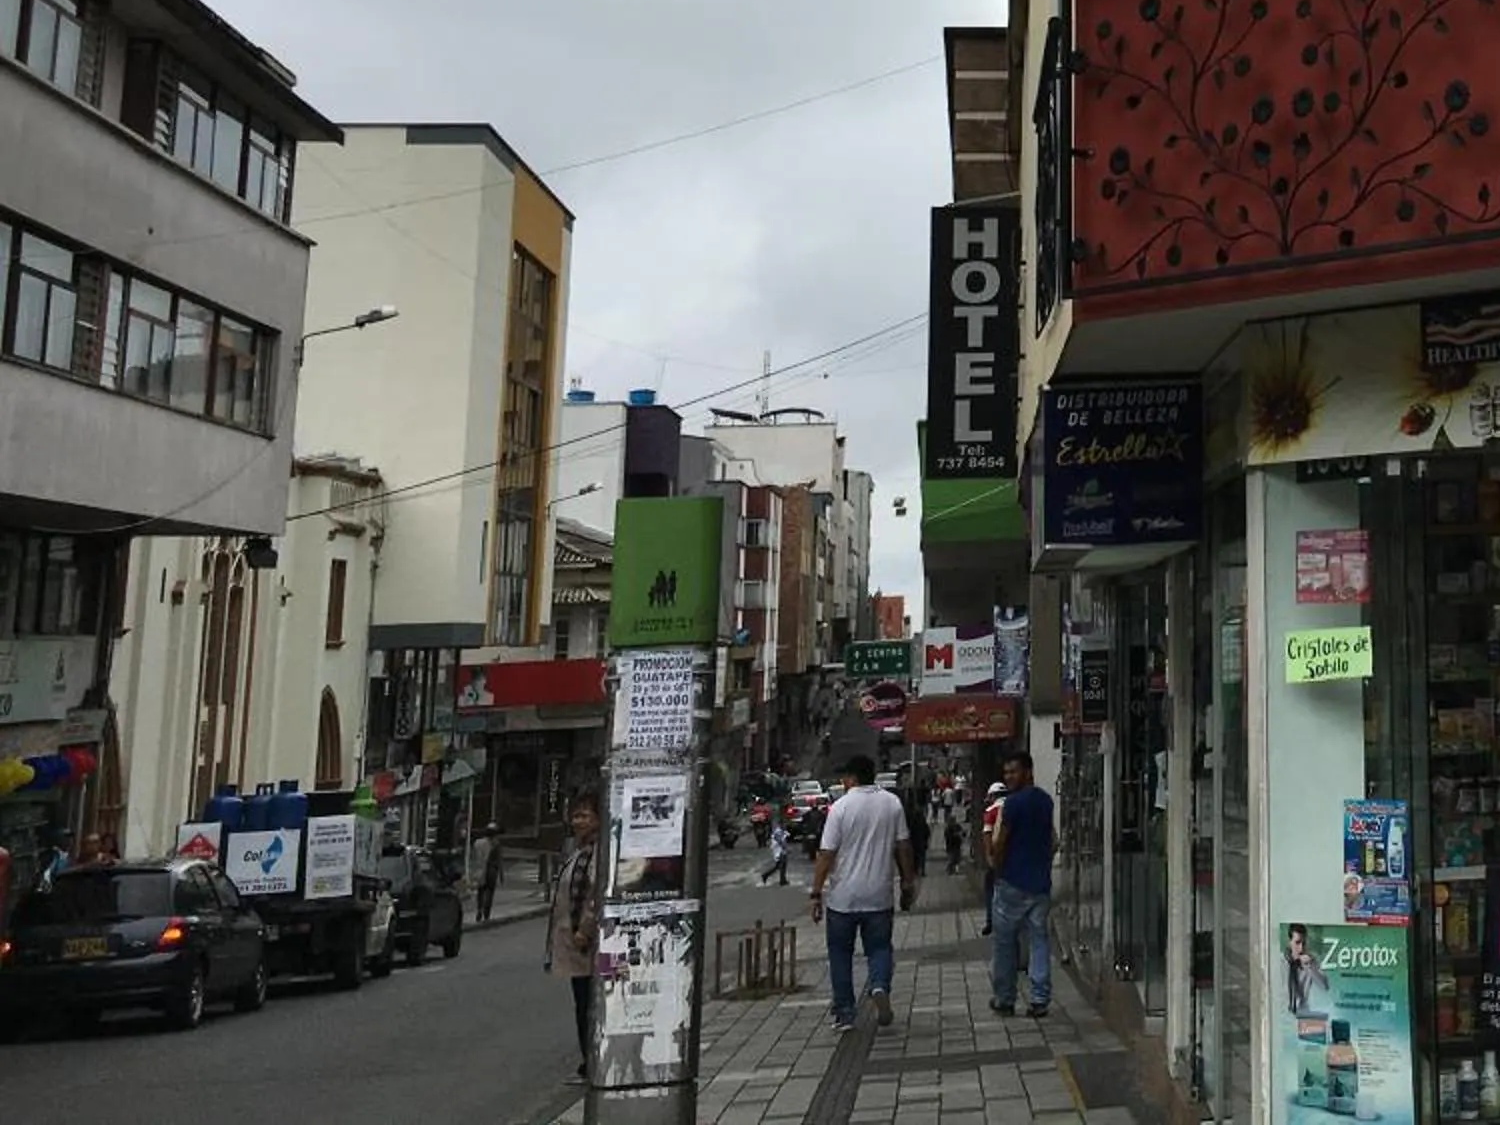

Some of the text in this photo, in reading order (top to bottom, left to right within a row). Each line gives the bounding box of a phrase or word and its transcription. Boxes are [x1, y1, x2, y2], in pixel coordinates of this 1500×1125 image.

[951, 217, 1001, 443] HOTEL
[1056, 387, 1189, 410] DISTRIBUIDORA
[1067, 406, 1180, 427] DE BELLEZA
[1287, 636, 1350, 660] Cristales
